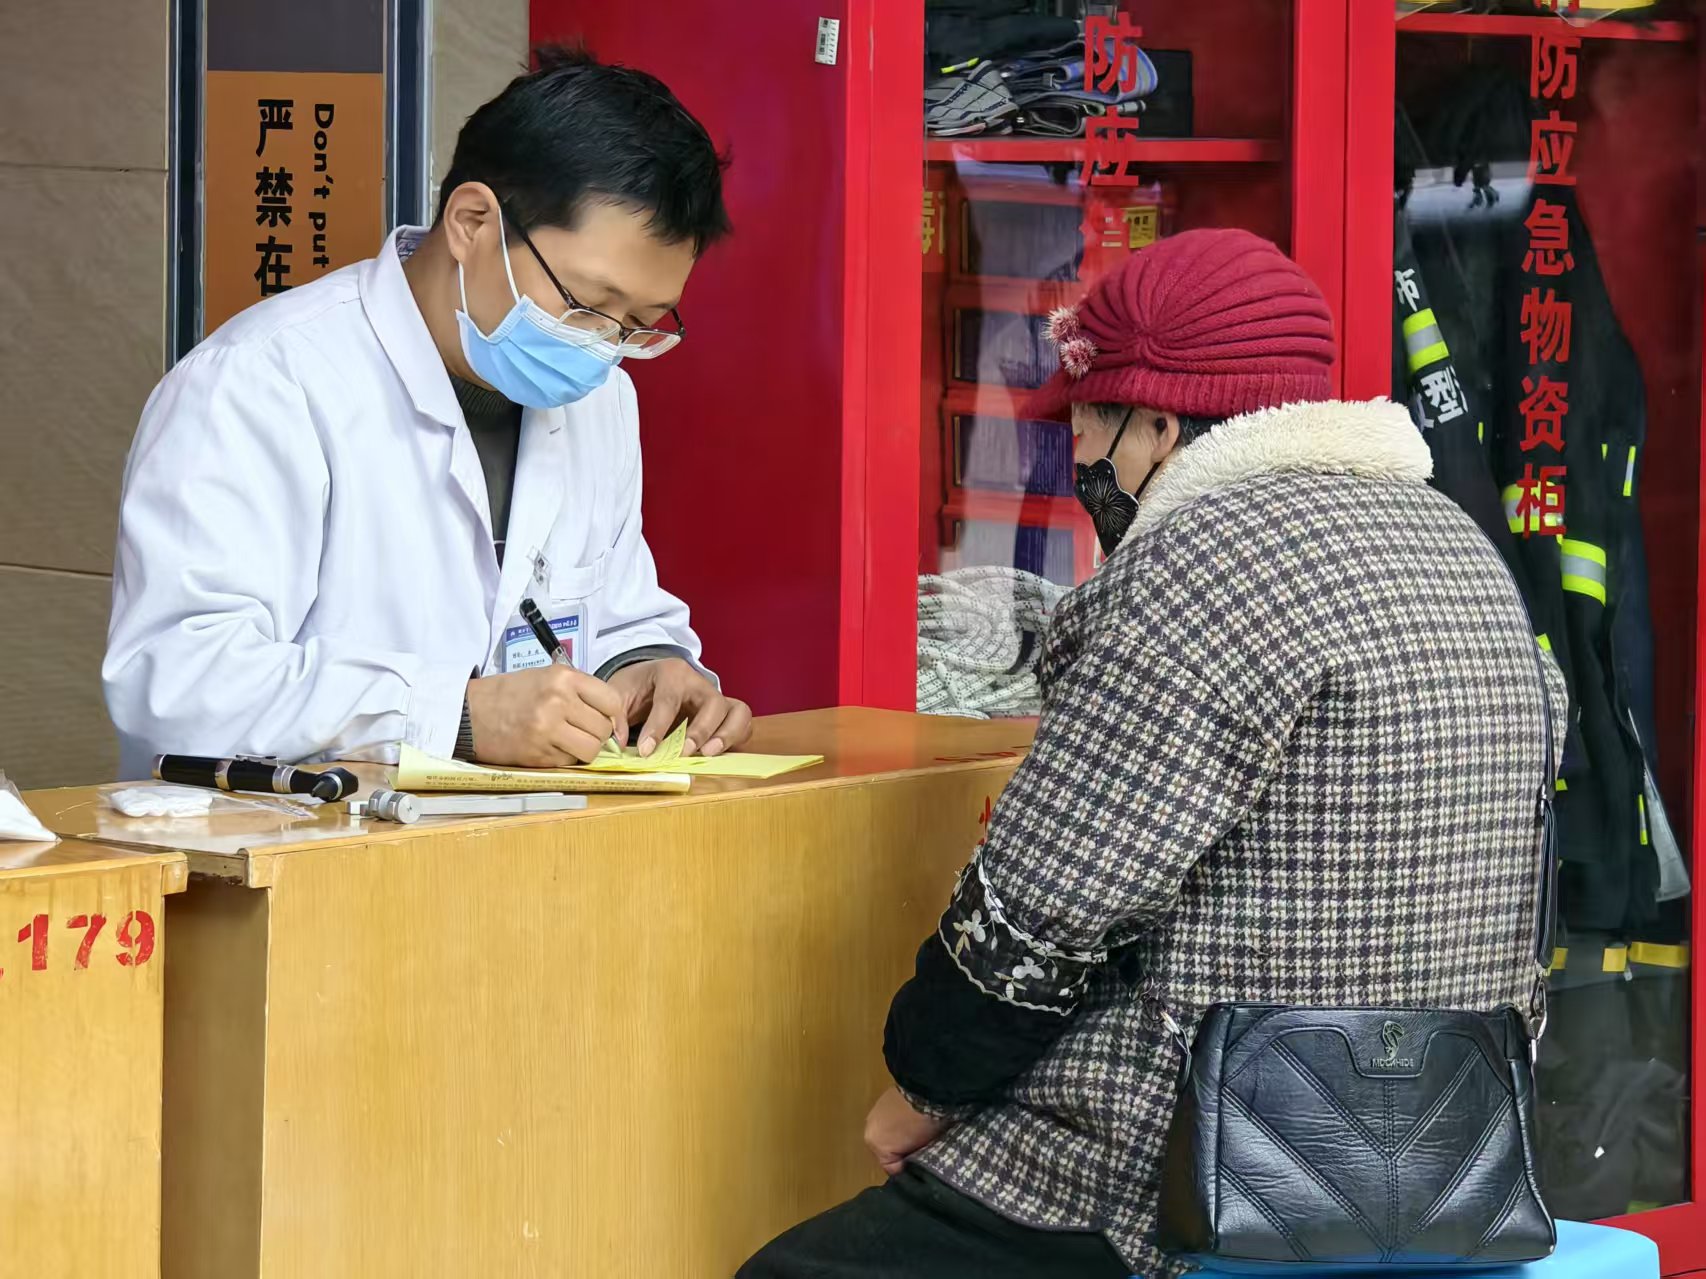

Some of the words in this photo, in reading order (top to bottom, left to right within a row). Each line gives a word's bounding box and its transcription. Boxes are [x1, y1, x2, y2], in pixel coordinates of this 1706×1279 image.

[254, 99, 294, 297] 严禁在
[313, 103, 335, 199] Don't
[308, 211, 330, 269] put
[1516, 0, 1583, 540] 防应急物资柜
[17, 910, 156, 971] 179
